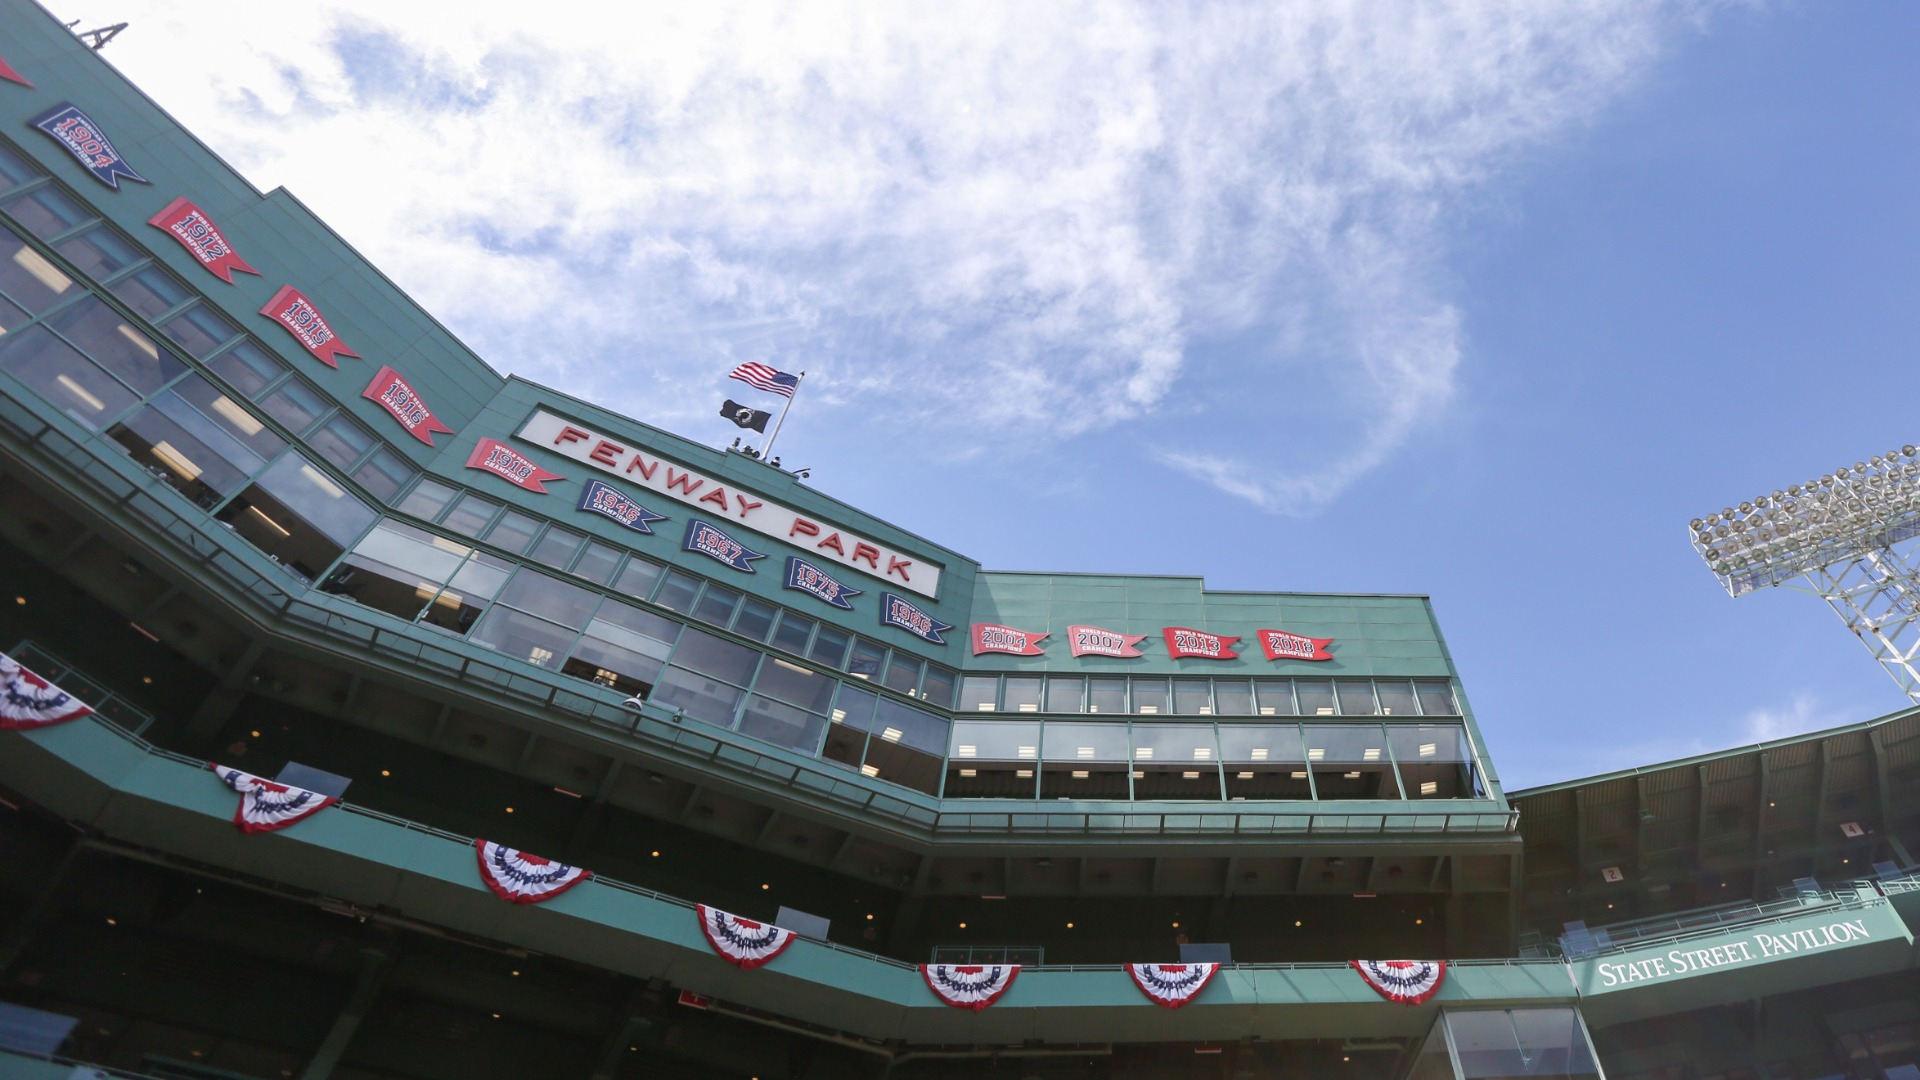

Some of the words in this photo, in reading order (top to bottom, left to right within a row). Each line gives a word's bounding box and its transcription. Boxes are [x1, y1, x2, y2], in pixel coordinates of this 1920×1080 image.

[53, 127, 96, 168] CHAMPIONS
[56, 118, 115, 168] 1904
[76, 116, 103, 142] AMERICAN
[101, 141, 118, 161] LEAGUE
[171, 224, 211, 263] CHAMPIONS
[178, 215, 225, 261] 1912
[191, 210, 214, 232] WORLD
[212, 232, 231, 254] SERIES
[280, 312, 317, 349] CHAMPIONS
[285, 303, 331, 345] 1915
[297, 297, 318, 318] WORLD
[316, 318, 335, 339] SERIES
[381, 394, 416, 429] CHAMPIONS
[385, 383, 425, 425] 1916
[395, 378, 414, 398] WORLD
[413, 397, 430, 418] SERIES
[487, 449, 533, 478] 1918
[494, 444, 517, 458] WORLD
[517, 456, 537, 471] SERIES
[484, 460, 525, 484] CHAMPIONS
[554, 425, 763, 518] FENWAY
[789, 517, 913, 582] PARK
[593, 490, 640, 522] 1946
[593, 502, 632, 525] CHAMPIONS
[697, 530, 742, 560] 1967
[697, 543, 735, 564] CHAMPIONS
[797, 567, 840, 598] 1975
[797, 580, 833, 601] CHAMPIONS
[891, 602, 932, 633] 1986
[892, 615, 927, 637] CHAMPIONS
[981, 630, 1027, 649] 2004
[1005, 629, 1026, 637] SERIES
[1077, 633, 1124, 650] 2007
[1101, 631, 1123, 639] SERIES
[1174, 635, 1221, 652] 2013
[1197, 632, 1218, 641] SERIES
[1268, 637, 1315, 654] 2018
[1290, 634, 1312, 643] SERIES
[985, 643, 1023, 653] CHAMPIONS
[1082, 645, 1122, 655] CHAMPIONS
[1179, 647, 1219, 657] CHAMPIONS
[1274, 649, 1314, 658] CHAMPIONS
[1607, 868, 1618, 880] 2
[1598, 957, 1670, 987] STATE
[1668, 940, 1752, 975] STREET
[1753, 919, 1871, 958] PAVILION
